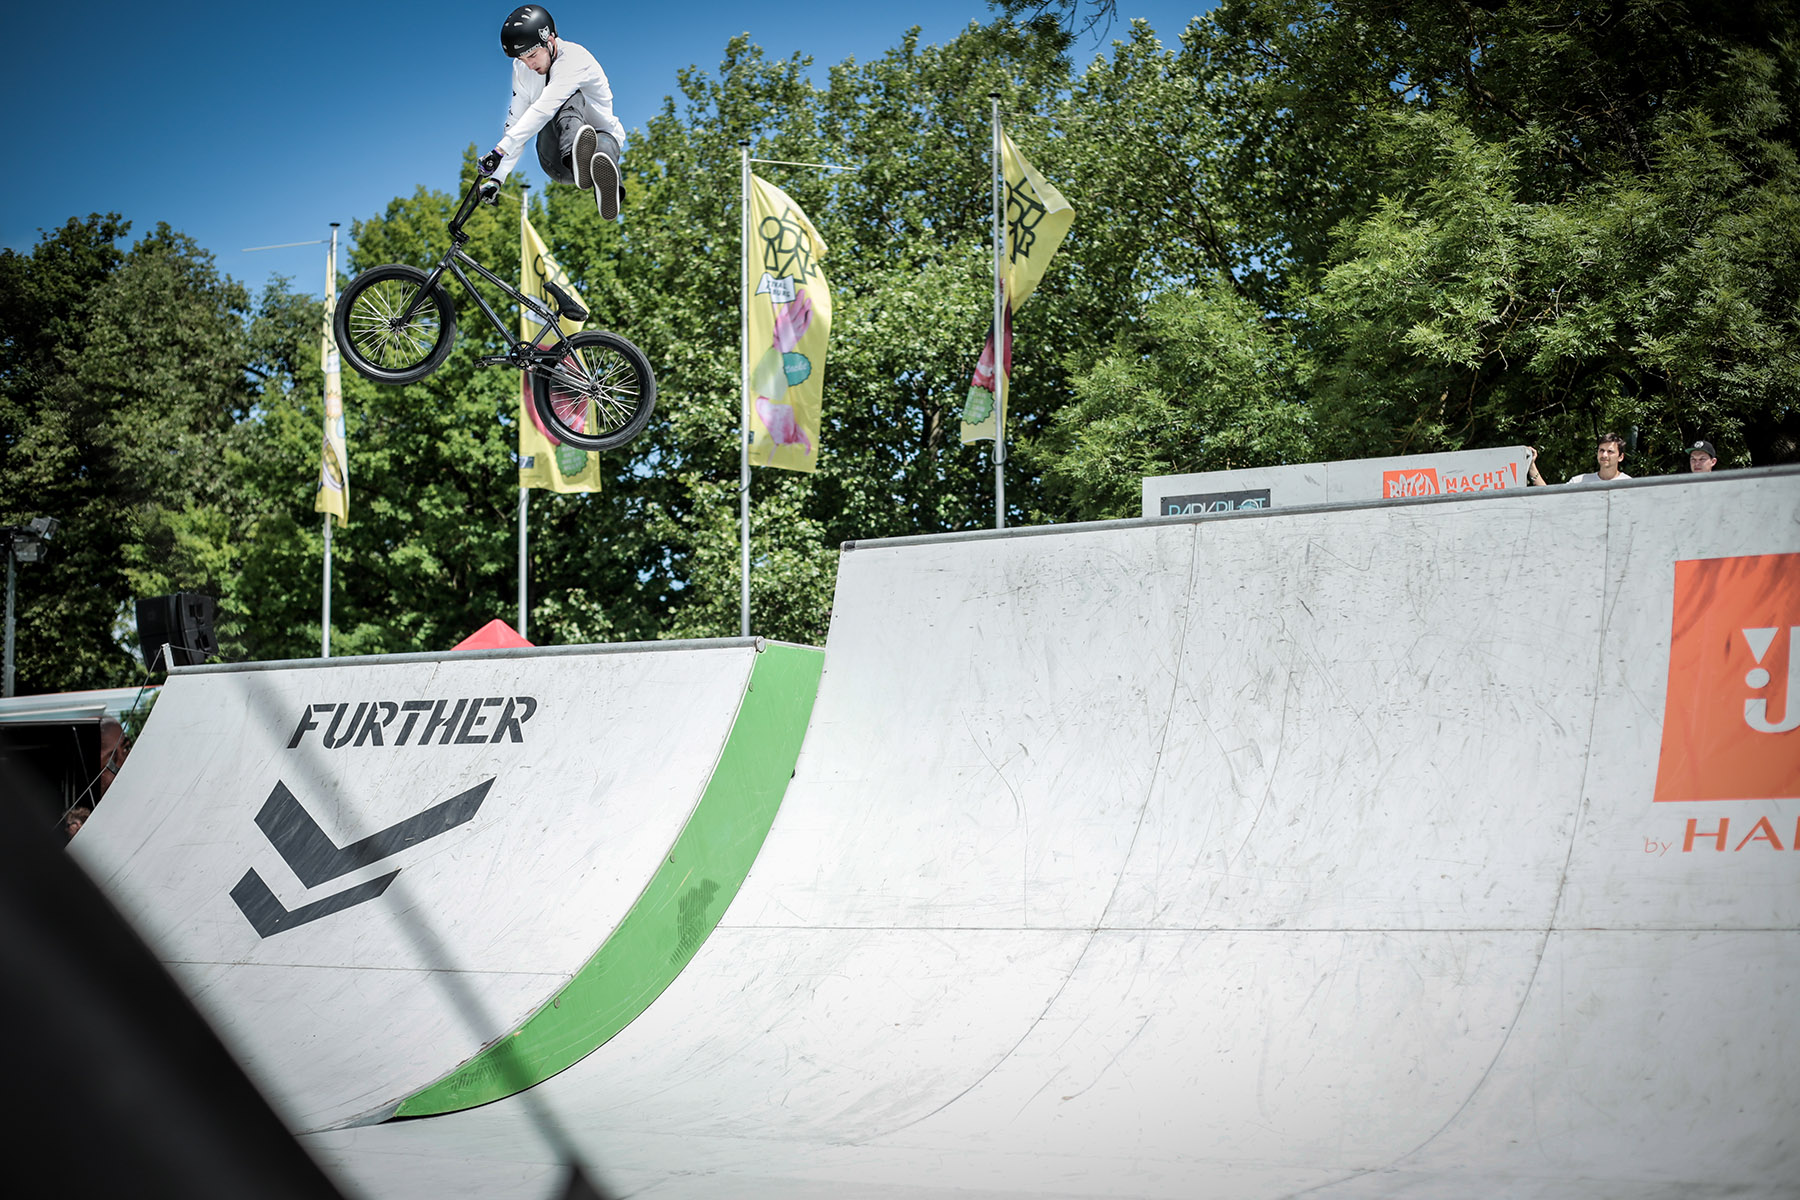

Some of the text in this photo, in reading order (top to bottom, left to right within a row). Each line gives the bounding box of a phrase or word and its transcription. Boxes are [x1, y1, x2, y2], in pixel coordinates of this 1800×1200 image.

[1445, 470, 1505, 490] MACHT
[286, 696, 538, 750] FURTHER
[1644, 815, 1800, 858] by HA
